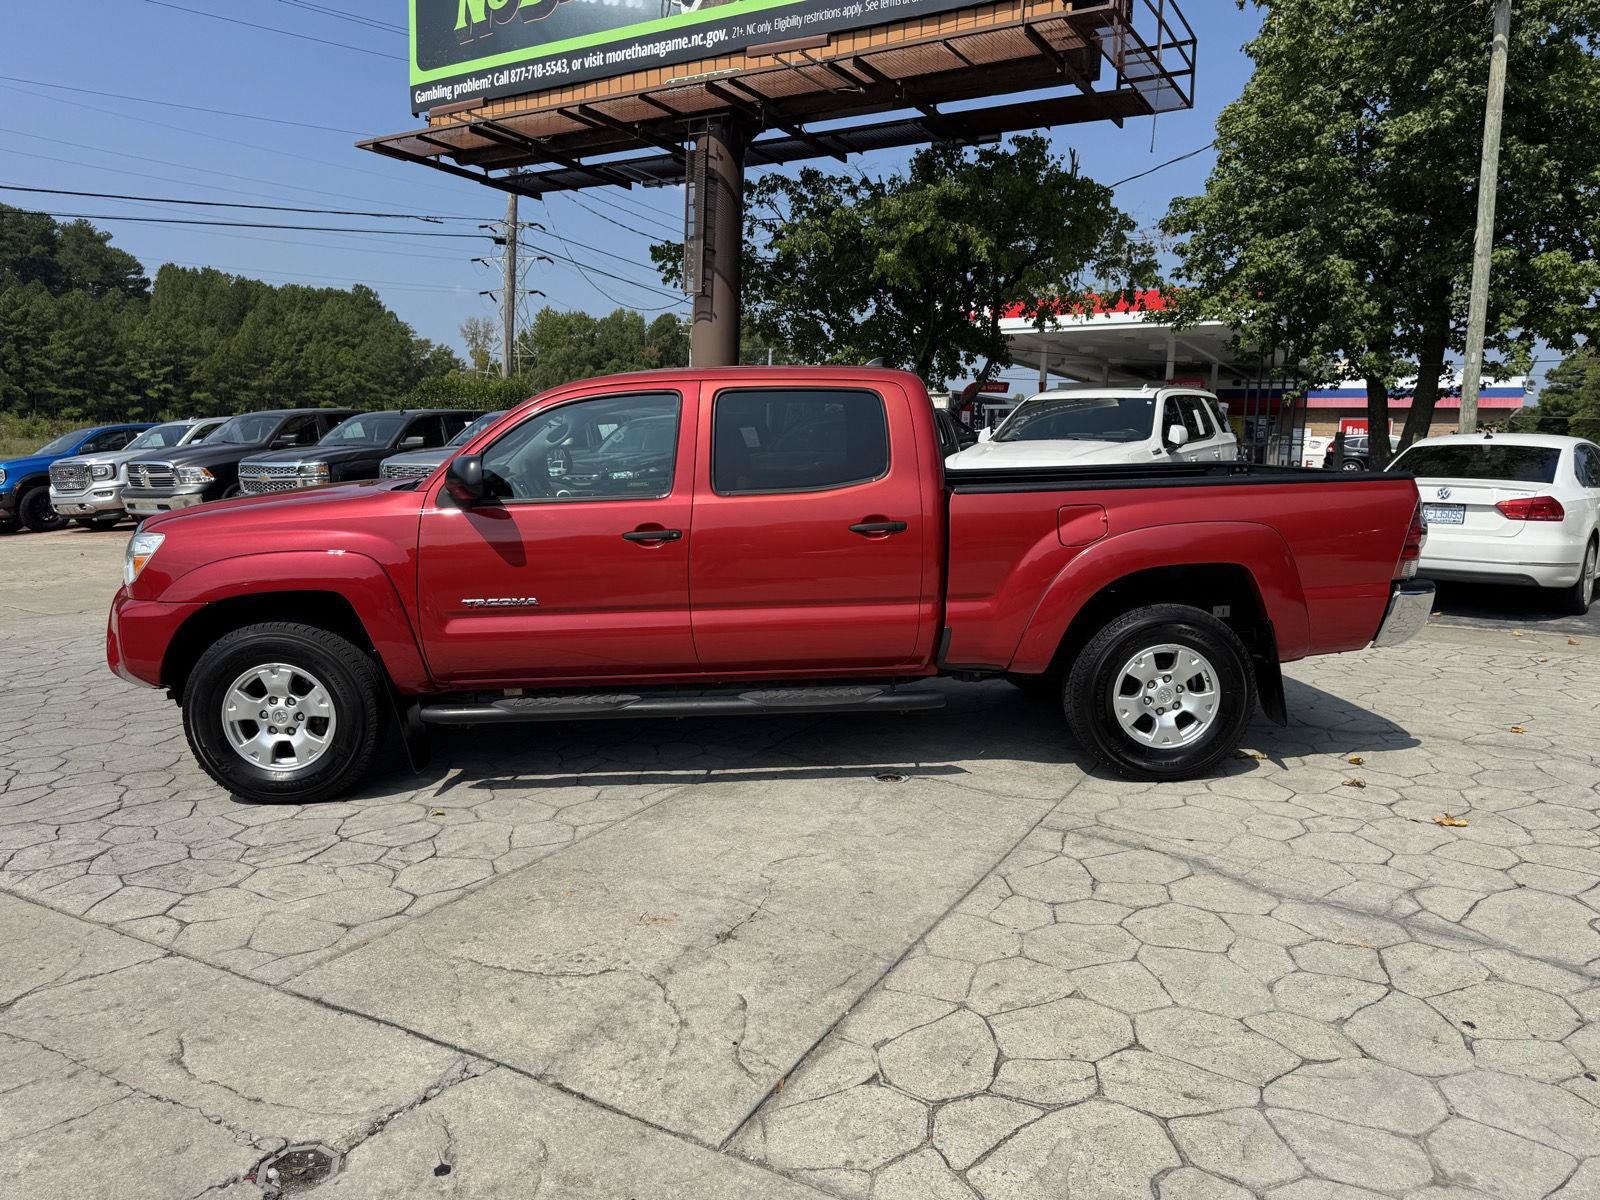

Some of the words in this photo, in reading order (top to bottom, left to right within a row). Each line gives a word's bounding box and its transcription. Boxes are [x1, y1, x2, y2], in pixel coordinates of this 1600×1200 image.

[415, 85, 452, 103] Gambling
[454, 75, 491, 98] problem?
[494, 70, 510, 86] Call
[510, 59, 570, 84] 877-718-5543,
[572, 58, 582, 71] or
[584, 51, 603, 68] visit
[606, 28, 728, 64] morethanagame.nc.gov.
[732, 26, 745, 38] 21+.
[746, 23, 758, 35] NC
[757, 20, 772, 35] only.
[774, 14, 803, 31] Eligibility
[804, 7, 841, 24] restrictions
[842, 1, 863, 18] apply.
[865, 0, 879, 12] See
[461, 597, 539, 607] TACOMA
